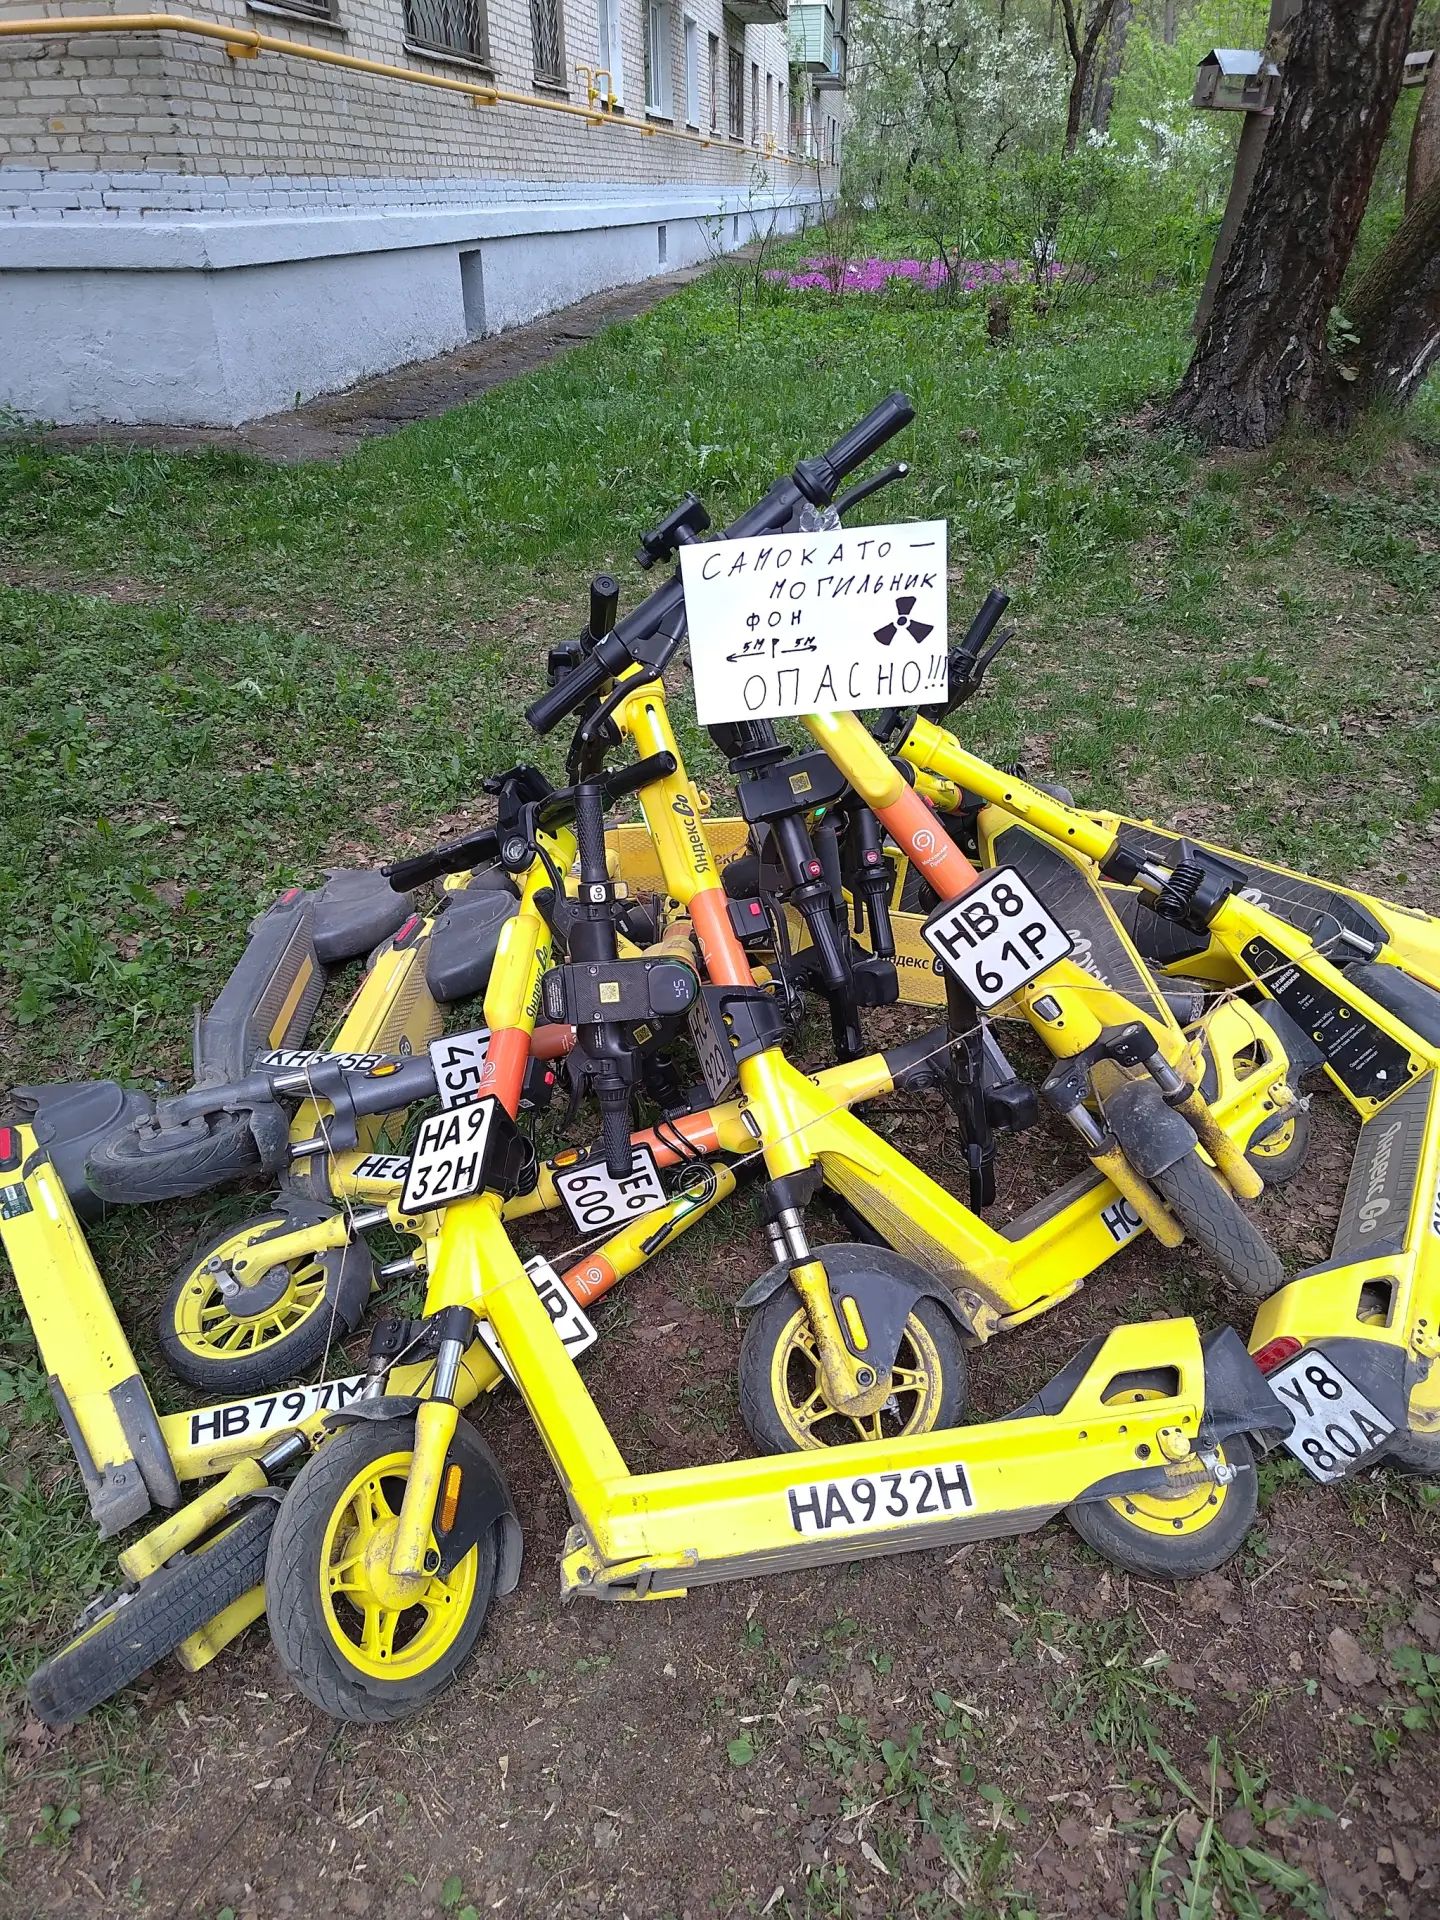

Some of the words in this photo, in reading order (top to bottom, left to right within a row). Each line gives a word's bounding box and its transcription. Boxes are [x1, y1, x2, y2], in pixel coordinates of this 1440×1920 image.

[769, 573, 938, 600] МОГИЛЬНИК
[746, 609, 802, 632] ФОН
[743, 654, 948, 711] ОПАСНО!!!
[672, 794, 695, 817] Go
[684, 818, 711, 874] Яндекс
[933, 883, 1024, 961] НВ8
[975, 922, 1047, 994] 61Р
[417, 1107, 486, 1157] НА9
[352, 1155, 412, 1180] НЕ6
[411, 1150, 479, 1201] 32Н
[1365, 1121, 1402, 1203] Яндекс
[1101, 1196, 1143, 1242] НС
[1358, 1197, 1391, 1234] Go
[190, 1377, 367, 1445] НВ797М
[1277, 1365, 1344, 1418] У8
[787, 1464, 973, 1532] НА932Н
